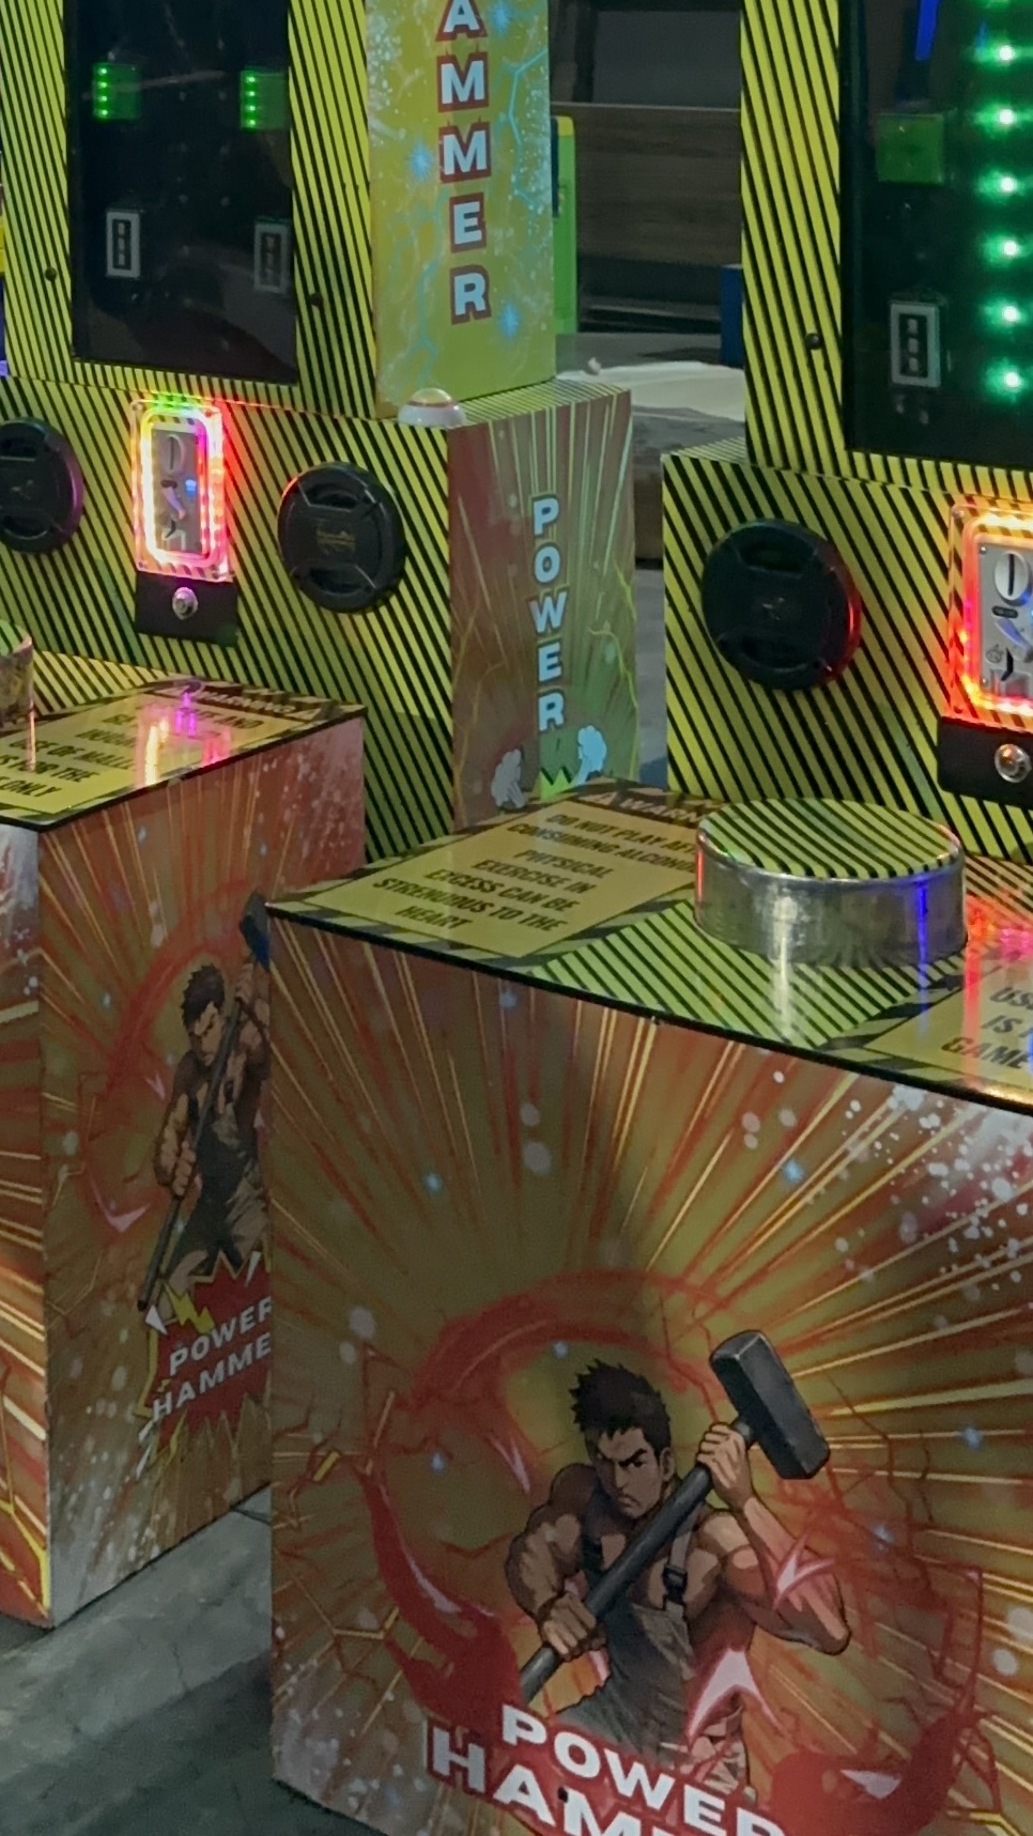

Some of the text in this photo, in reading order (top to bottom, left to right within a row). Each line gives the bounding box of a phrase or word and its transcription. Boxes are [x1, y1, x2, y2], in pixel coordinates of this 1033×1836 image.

[527, 495, 568, 732] POWER
[619, 798, 704, 823] WARN
[507, 823, 620, 854] CONSUMING
[575, 820, 618, 835] NOT
[613, 828, 669, 846] PLAY
[472, 859, 597, 894] EXERCISE IN
[514, 848, 615, 879] PHYSICAL
[373, 877, 569, 932] STRENUOUS TO THE
[424, 868, 581, 912] EXCESS CAN BE
[395, 905, 473, 930] HEART
[153, 1332, 272, 1422] HAMME
